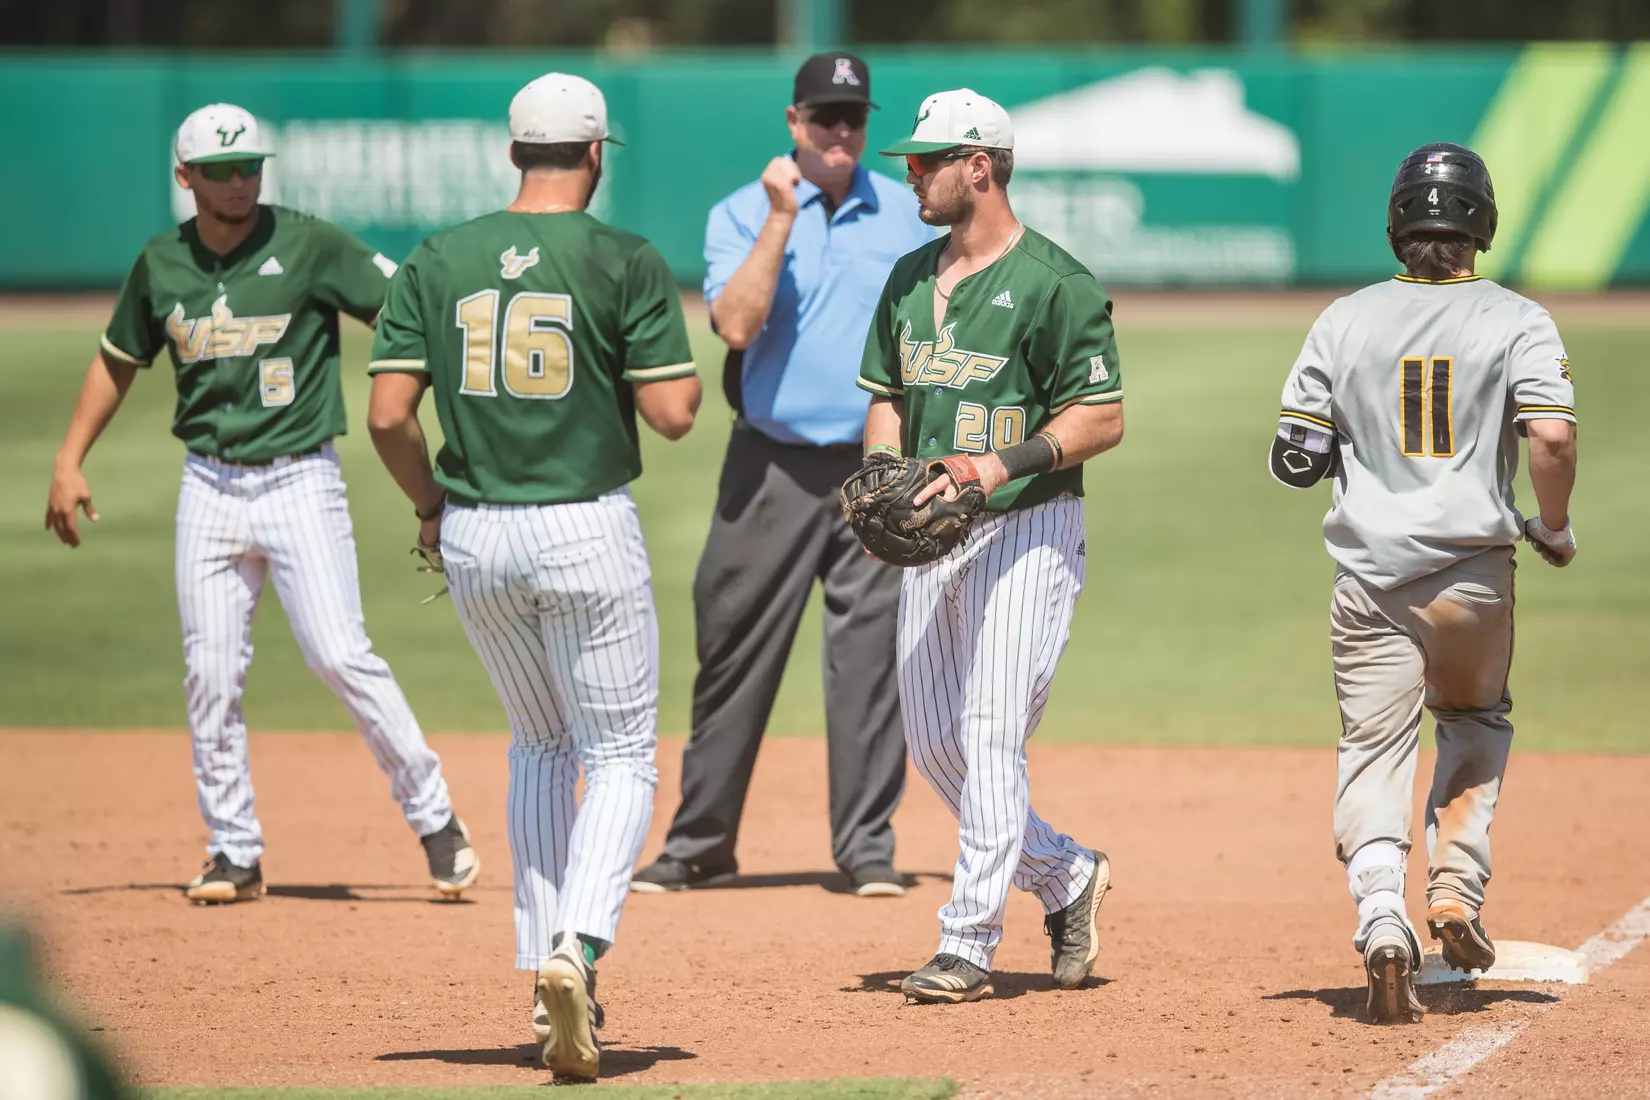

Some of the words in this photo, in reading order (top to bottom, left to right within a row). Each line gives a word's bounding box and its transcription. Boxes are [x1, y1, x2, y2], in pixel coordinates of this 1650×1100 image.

[1427, 187, 1439, 206] 4
[165, 293, 292, 364] USF
[455, 287, 574, 400] 16
[899, 318, 1010, 390] USF
[258, 356, 296, 408] 5
[1088, 354, 1109, 384] A
[953, 401, 1026, 453] 20
[1400, 356, 1455, 457] 11
